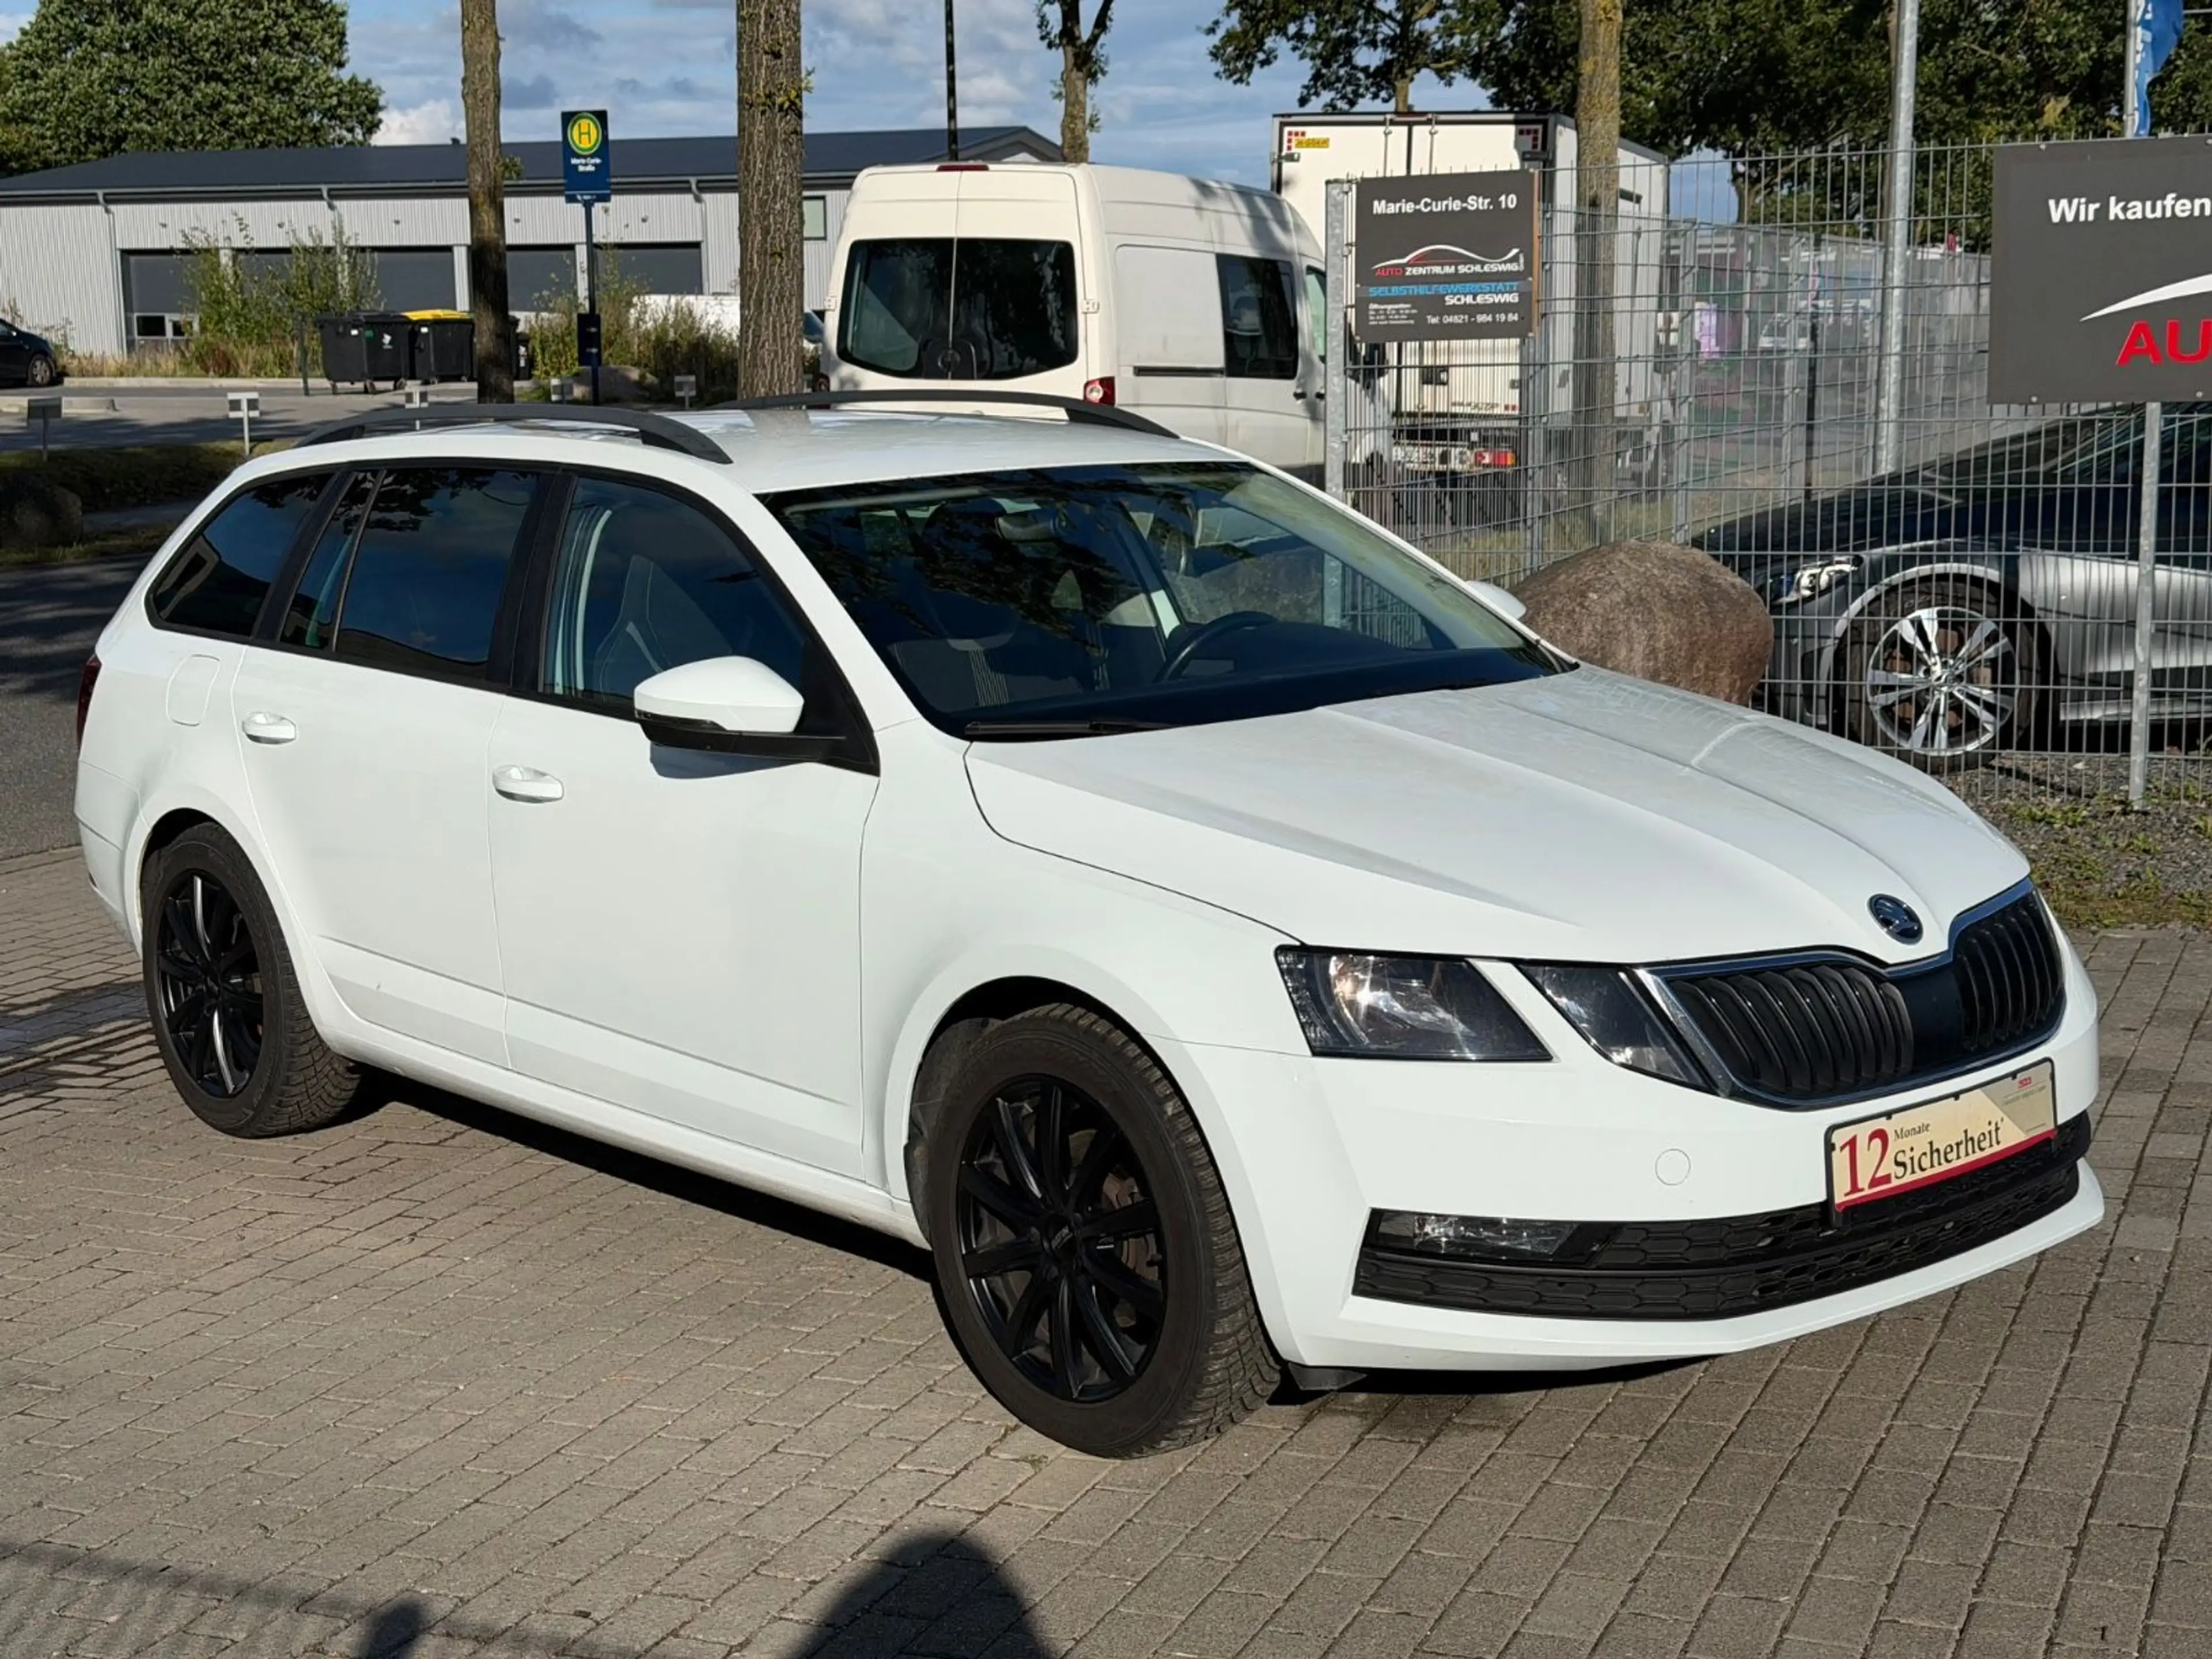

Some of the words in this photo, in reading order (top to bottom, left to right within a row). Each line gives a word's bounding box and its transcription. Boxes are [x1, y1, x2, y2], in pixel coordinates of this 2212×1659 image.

[578, 122, 591, 144] H
[1373, 196, 1493, 214] Marie-Curie-Str.
[1498, 194, 1517, 209] 10
[2048, 198, 2100, 223] Wir
[2109, 193, 2211, 221] kaufen
[1375, 268, 1403, 276] AUTO
[1405, 265, 1455, 276] ZENTRUM
[1457, 263, 1520, 273] SCHLESWIG
[1445, 293, 1519, 305] SCHLESWIG
[1894, 1122, 1930, 1141] Monate
[1840, 1127, 1892, 1197] 12
